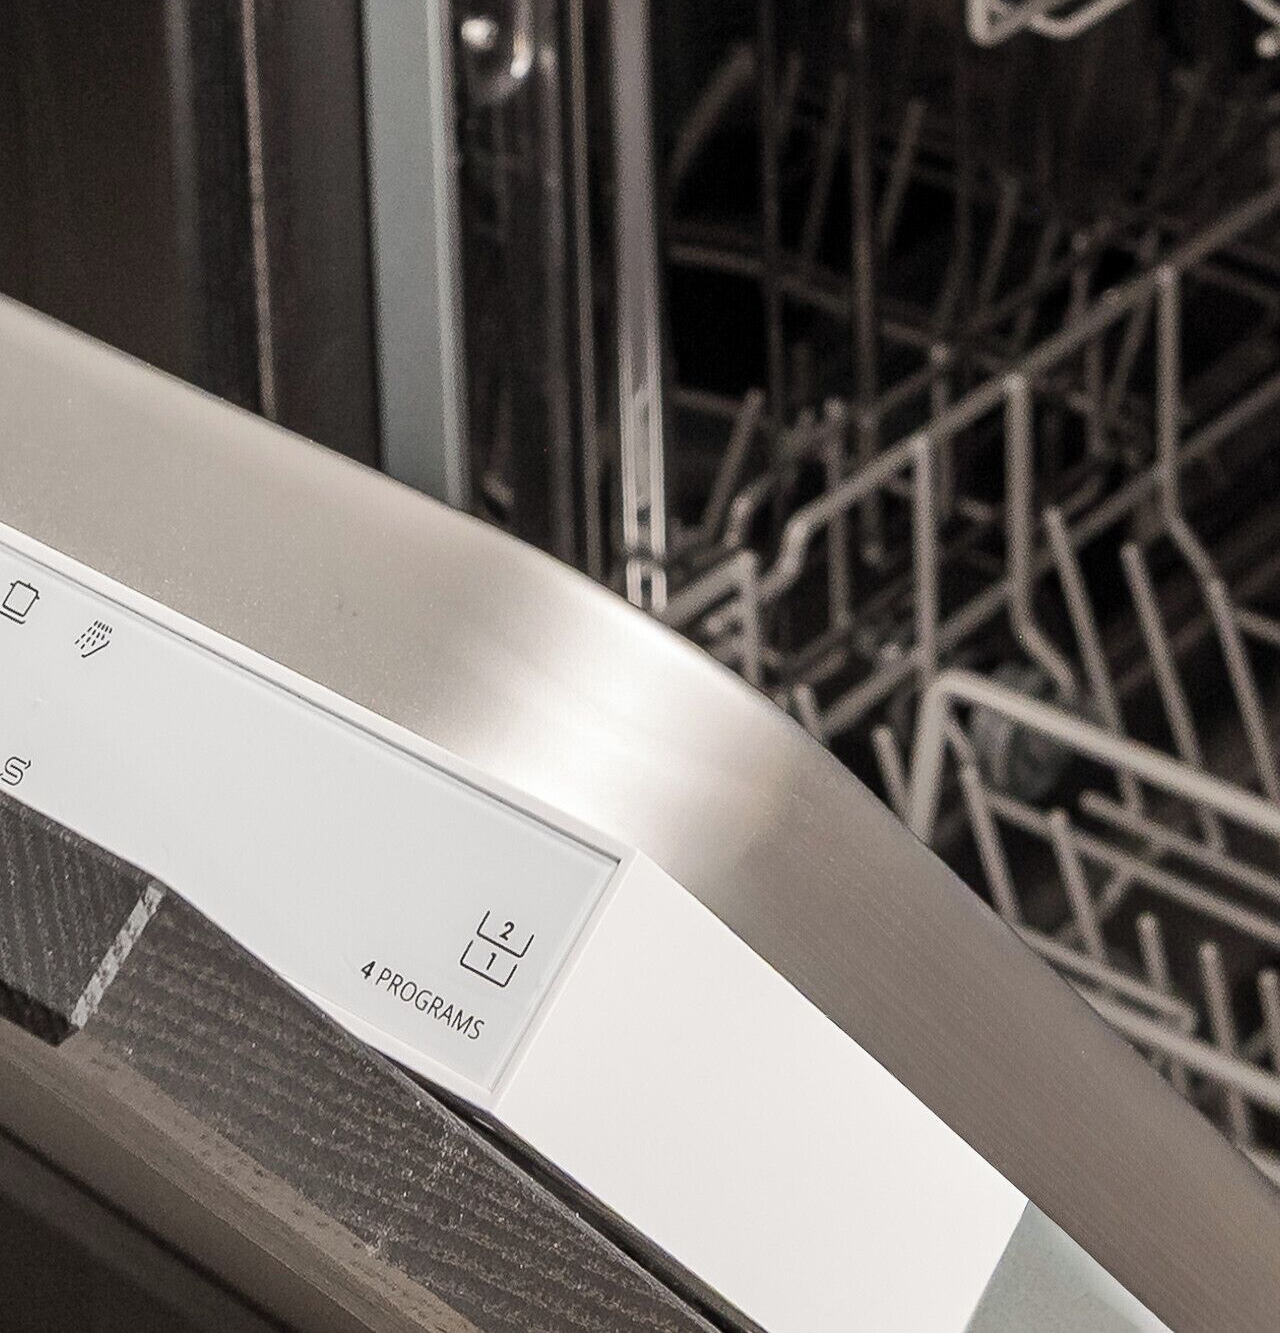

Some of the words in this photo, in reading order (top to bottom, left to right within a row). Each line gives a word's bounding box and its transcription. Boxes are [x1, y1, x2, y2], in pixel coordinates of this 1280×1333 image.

[498, 921, 515, 942] 2
[485, 951, 498, 971] 1
[360, 960, 377, 980] 4
[375, 967, 485, 1040] PROGRAMS
